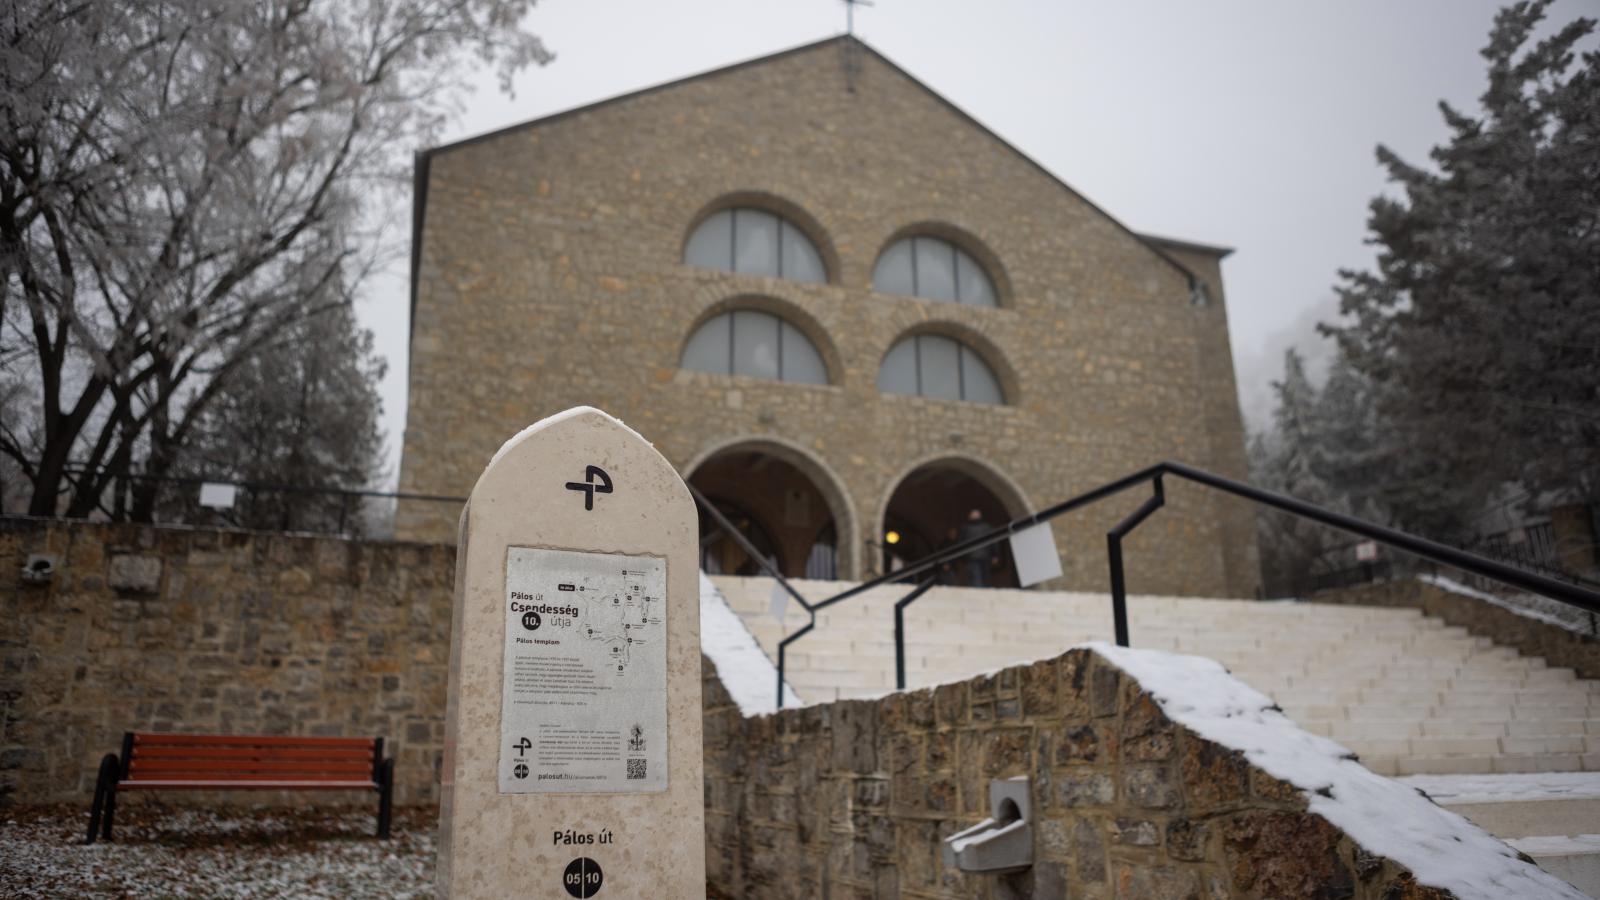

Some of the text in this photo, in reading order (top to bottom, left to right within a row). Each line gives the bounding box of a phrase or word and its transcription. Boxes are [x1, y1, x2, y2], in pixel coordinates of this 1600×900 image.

[511, 591, 543, 601] Pálos út
[510, 601, 579, 618] Csendesség
[524, 616, 540, 626] 10.
[550, 615, 571, 629] útja
[553, 828, 613, 845] Pálos út
[566, 872, 600, 884] 05 10
